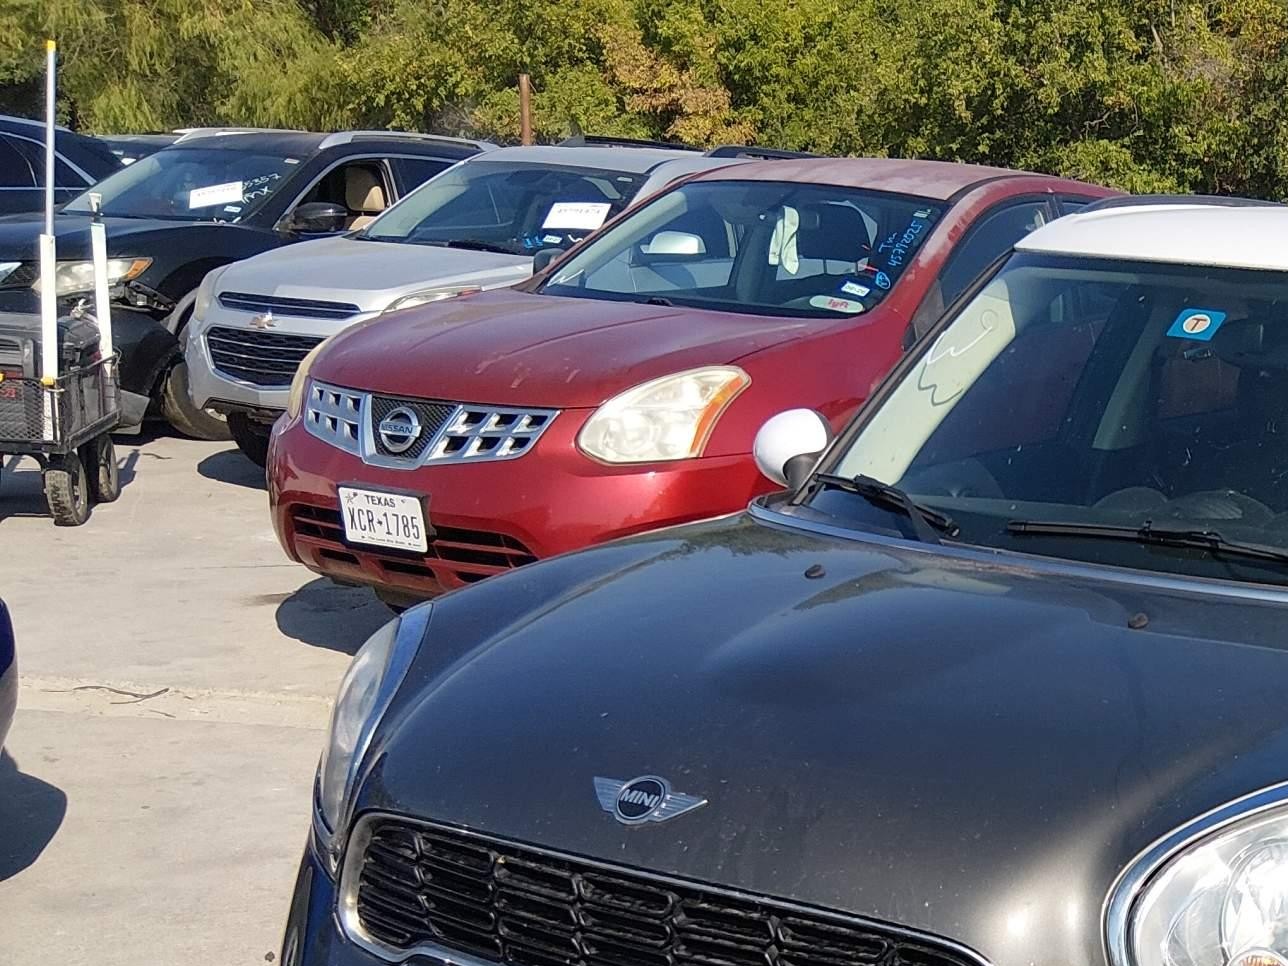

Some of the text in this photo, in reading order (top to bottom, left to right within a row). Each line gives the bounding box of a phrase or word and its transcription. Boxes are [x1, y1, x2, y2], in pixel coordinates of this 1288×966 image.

[381, 423, 413, 434] NISSAN
[364, 494, 396, 508] TEXAS
[620, 788, 660, 808] MINI
